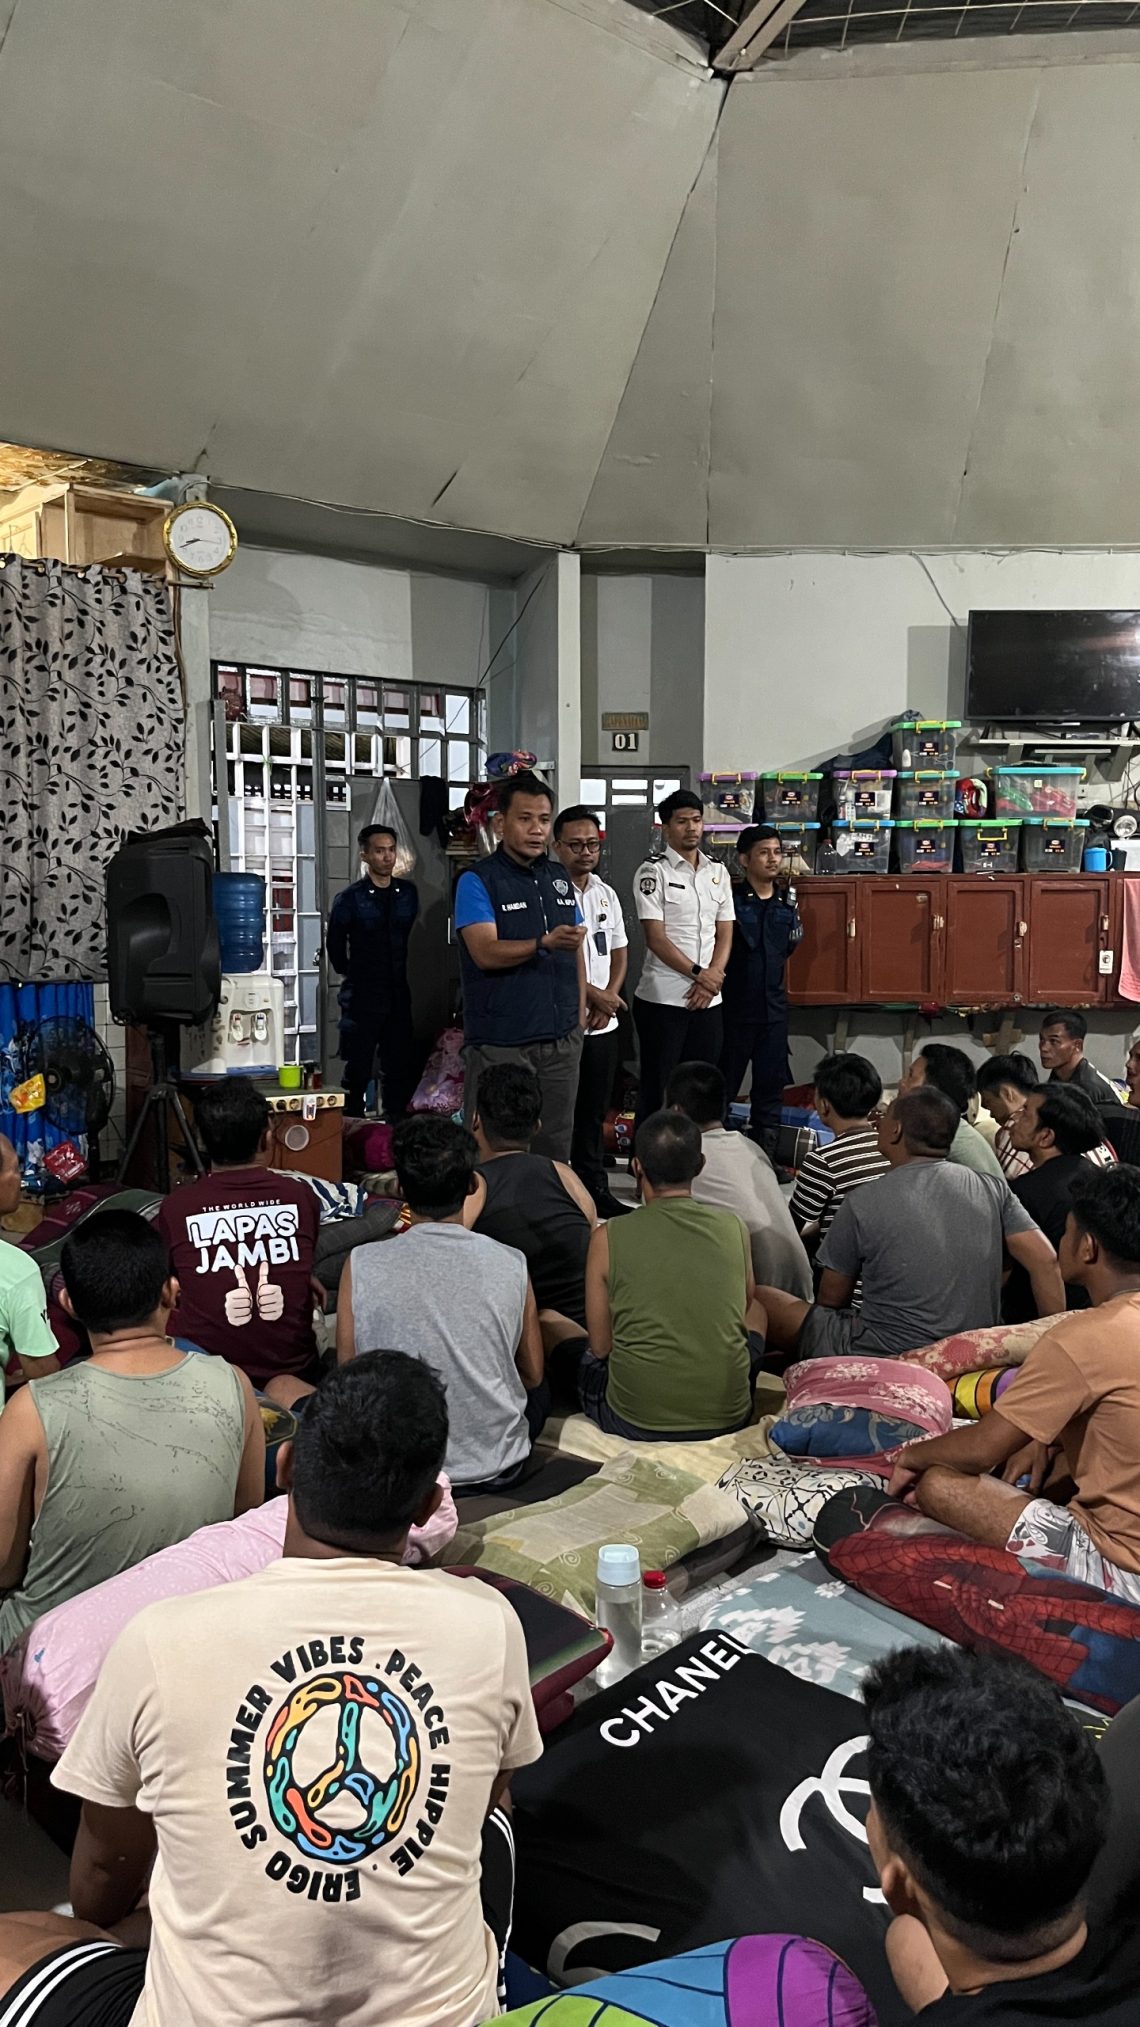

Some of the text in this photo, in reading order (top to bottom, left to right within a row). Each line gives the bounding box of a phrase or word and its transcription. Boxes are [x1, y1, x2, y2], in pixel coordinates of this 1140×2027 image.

[614, 733, 637, 750] 01
[223, 1201, 256, 1210] WORLD
[189, 1211, 297, 1249] LAPAS
[195, 1236, 300, 1274] JAMBI
[599, 1633, 757, 1748] CHANEL
[226, 1635, 451, 1903] SUMMER VIBES PEACE HIPPIE ERIGO
